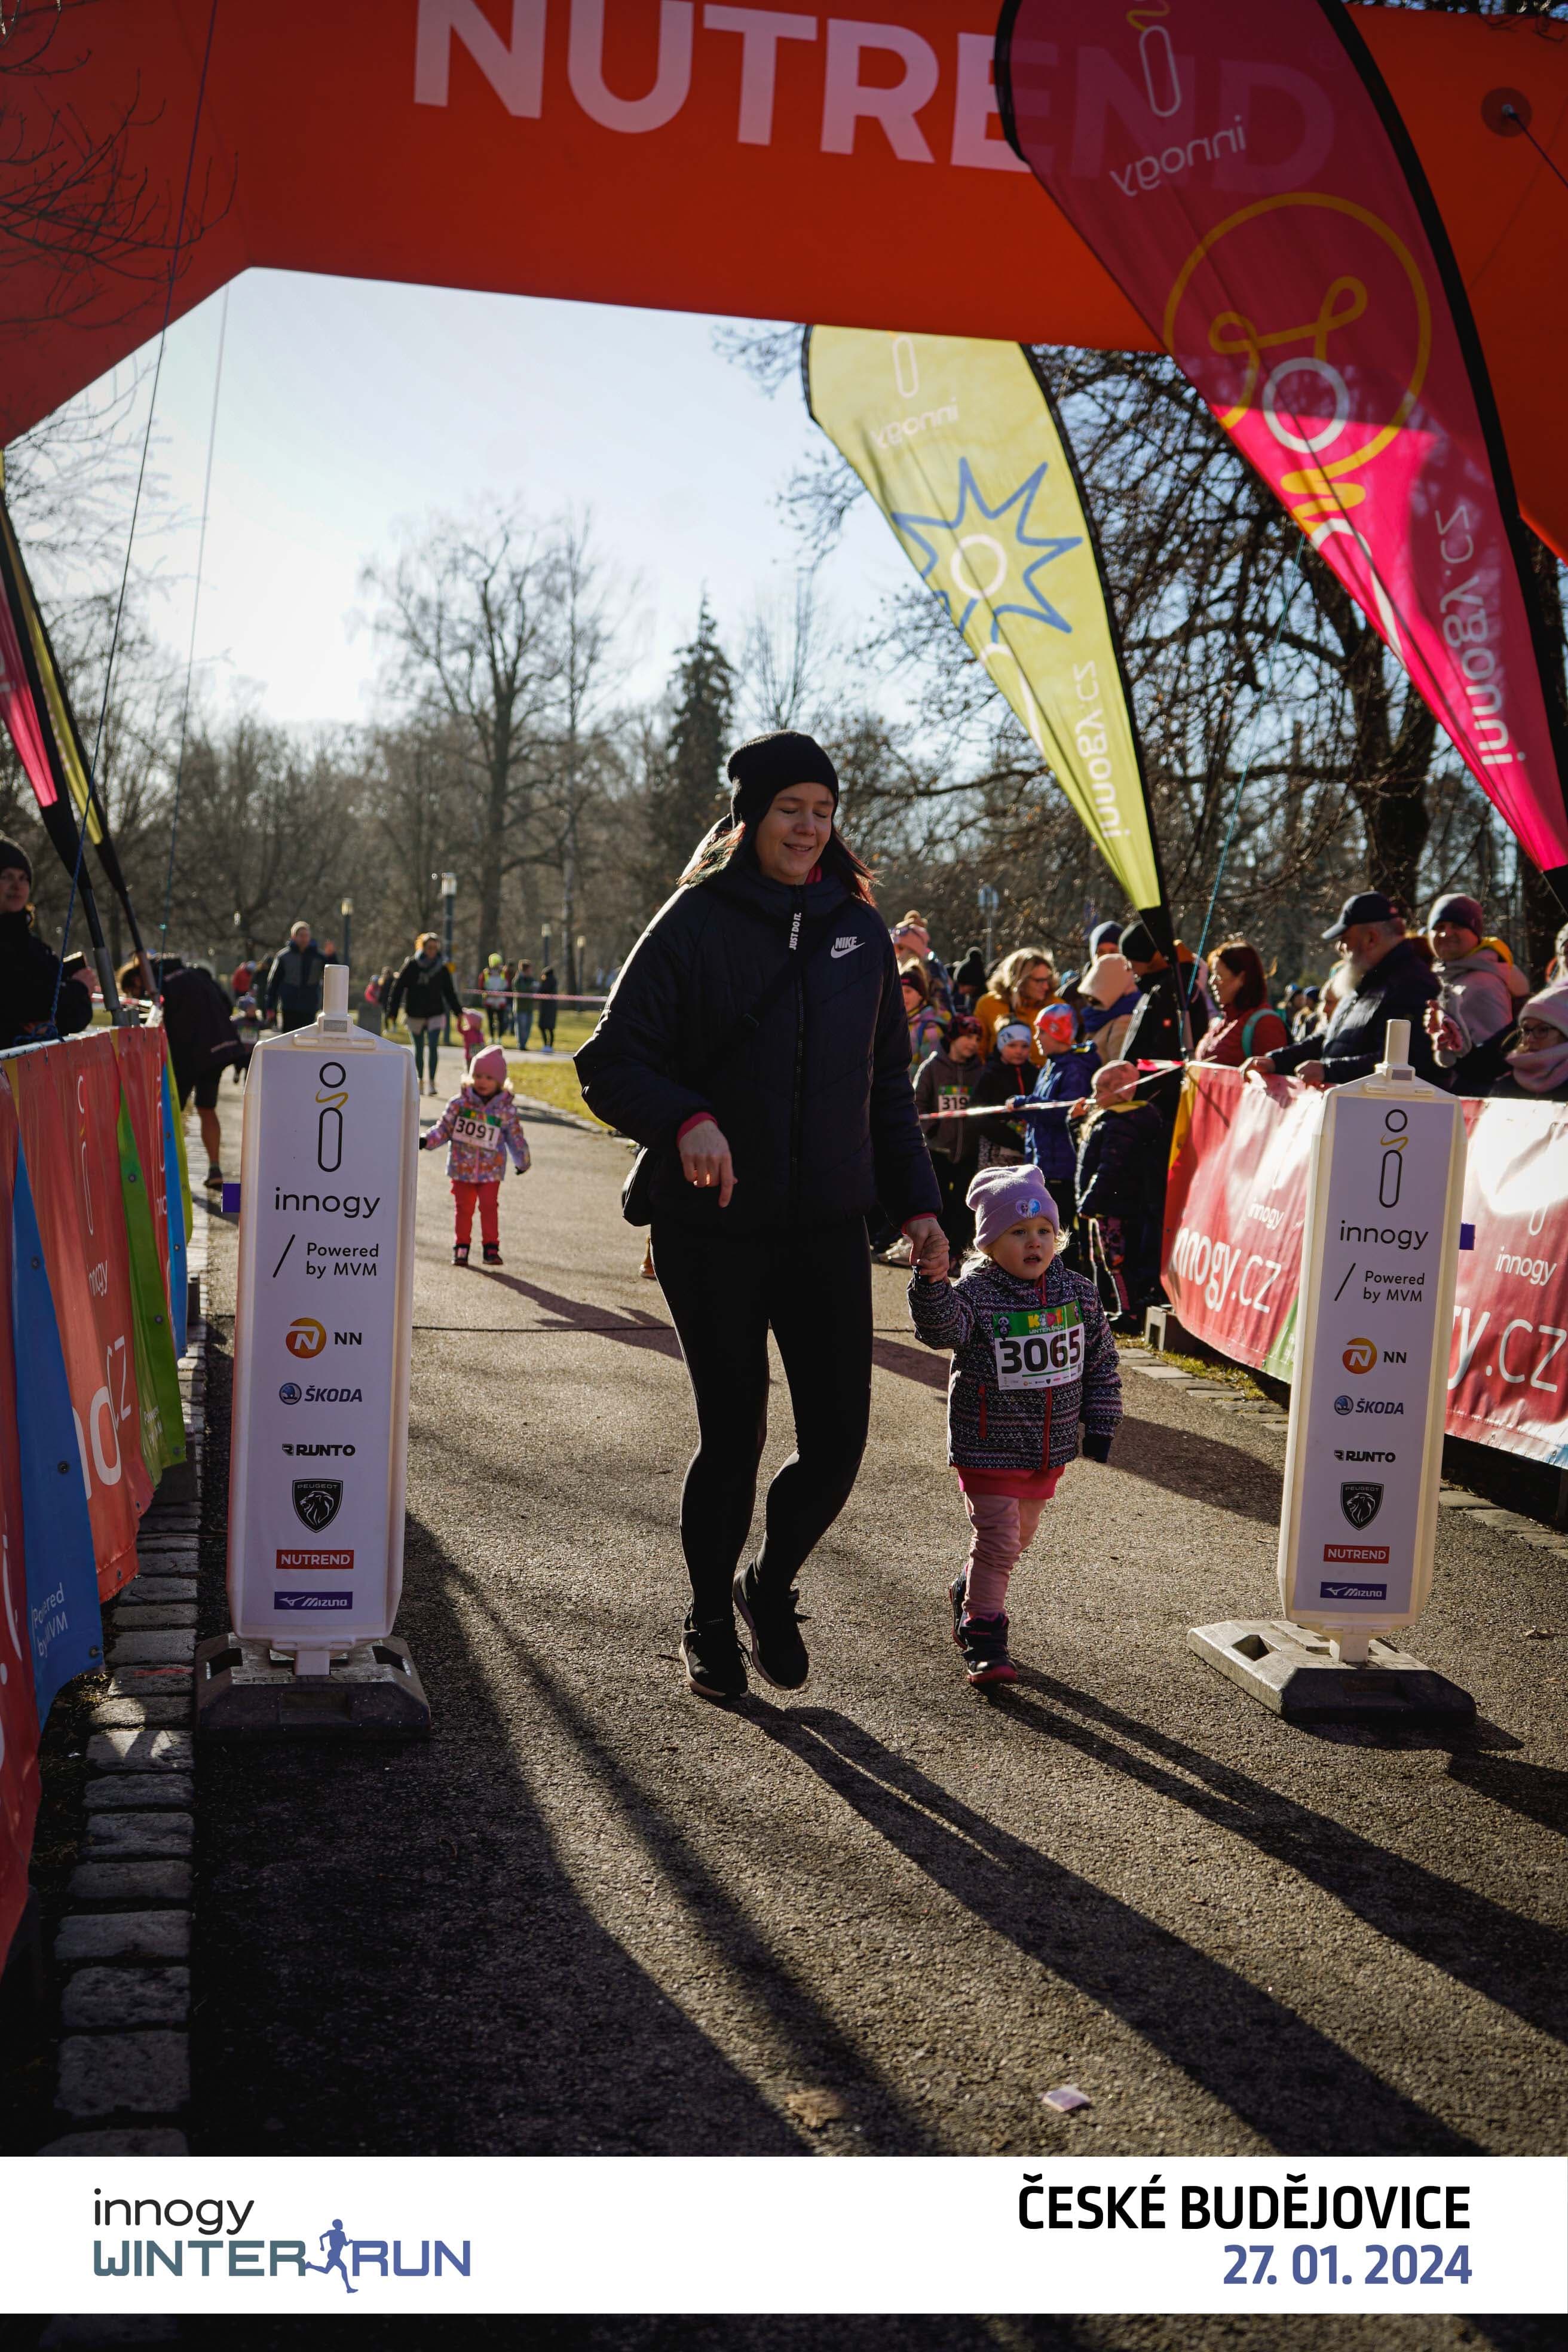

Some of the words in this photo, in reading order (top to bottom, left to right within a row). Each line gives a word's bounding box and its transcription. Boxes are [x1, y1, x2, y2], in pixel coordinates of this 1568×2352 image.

[792, 921, 800, 932] DO
[789, 932, 798, 950] JUST
[835, 936, 858, 949] NIKE
[942, 1097, 966, 1110] 319
[456, 1119, 494, 1141] 3091
[274, 1187, 381, 1218] innogy
[1340, 1220, 1429, 1250] innogy
[307, 1243, 379, 1258] Powered
[306, 1260, 326, 1279] by
[333, 1262, 378, 1276] MVM
[1495, 1246, 1557, 1286] innogy
[1365, 1270, 1425, 1285] Powered
[1363, 1287, 1381, 1303] by
[1386, 1289, 1423, 1302] MVM
[334, 1332, 362, 1345] NN
[999, 1328, 1080, 1374] 3065
[1383, 1351, 1407, 1364] NN
[304, 1385, 363, 1402] ŠKODA
[1355, 1398, 1404, 1414] ŠKODA
[296, 1444, 356, 1456] RUNTO
[1346, 1450, 1396, 1463] RUNTO
[281, 1554, 351, 1565] NUTREND
[1328, 1548, 1386, 1560] NUTREND
